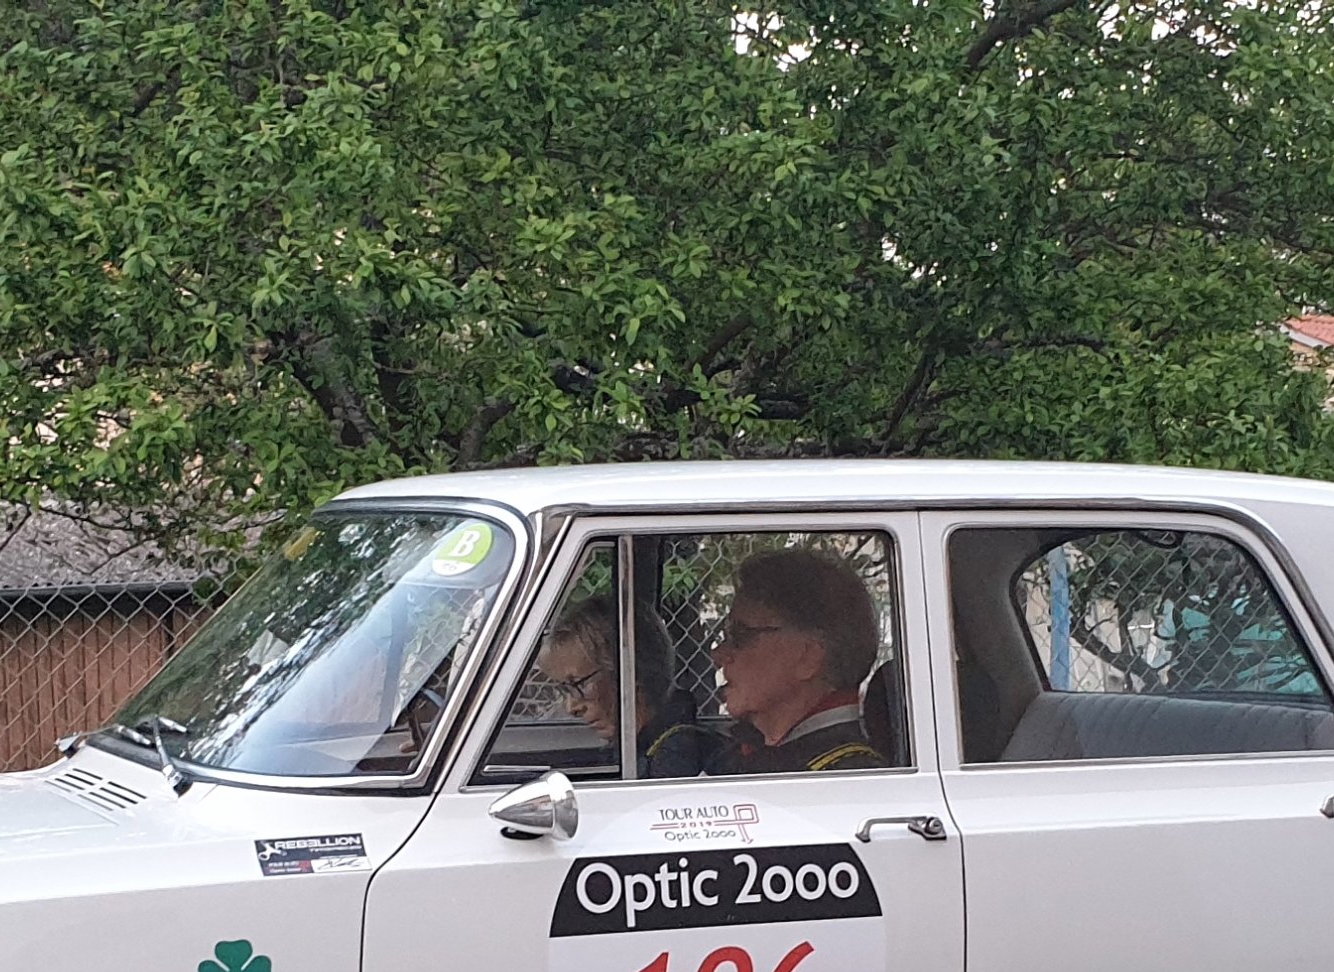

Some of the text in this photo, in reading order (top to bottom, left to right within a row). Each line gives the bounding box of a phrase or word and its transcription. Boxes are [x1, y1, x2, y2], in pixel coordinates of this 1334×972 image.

[448, 530, 481, 557] B
[659, 805, 729, 821] TOUR AUTO
[664, 828, 736, 842] Optic 2000
[575, 853, 859, 928] Optic 2000
